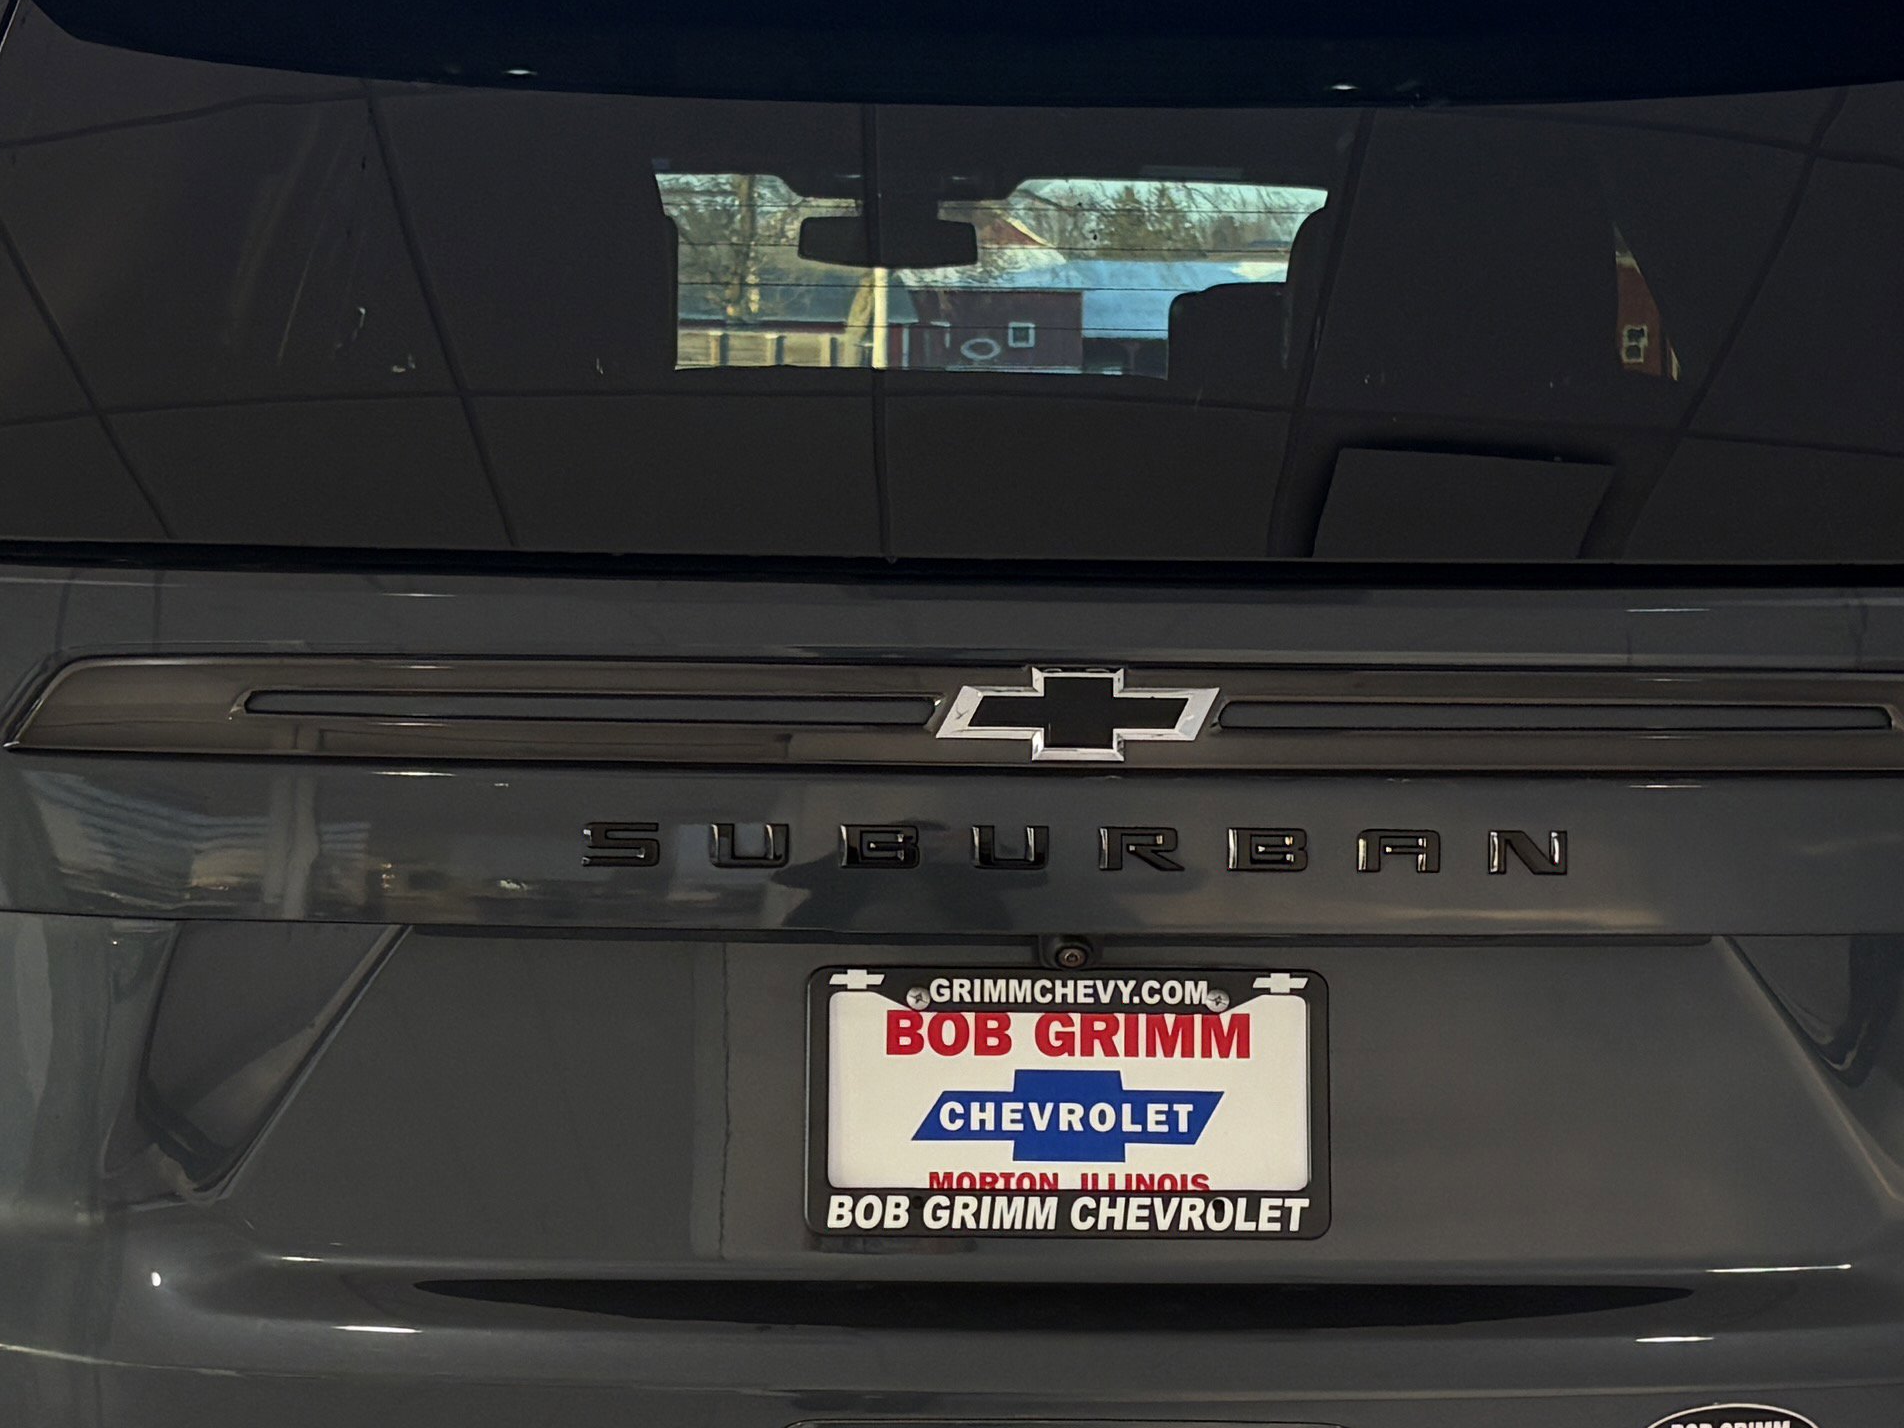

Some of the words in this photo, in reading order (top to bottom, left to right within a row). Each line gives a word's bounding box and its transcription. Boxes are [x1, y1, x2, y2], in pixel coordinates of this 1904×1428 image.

[582, 821, 1571, 876] SUBURBAN
[929, 976, 1209, 1006] GRIMMCHEVY.COM
[886, 1010, 1012, 1056] BOB
[1035, 1012, 1250, 1060] GRIMM
[939, 1100, 1194, 1133] CHEVROLET
[827, 1194, 910, 1230] BOB
[922, 1194, 1058, 1231] GRIMM
[1069, 1196, 1310, 1233] CHEVROLET
